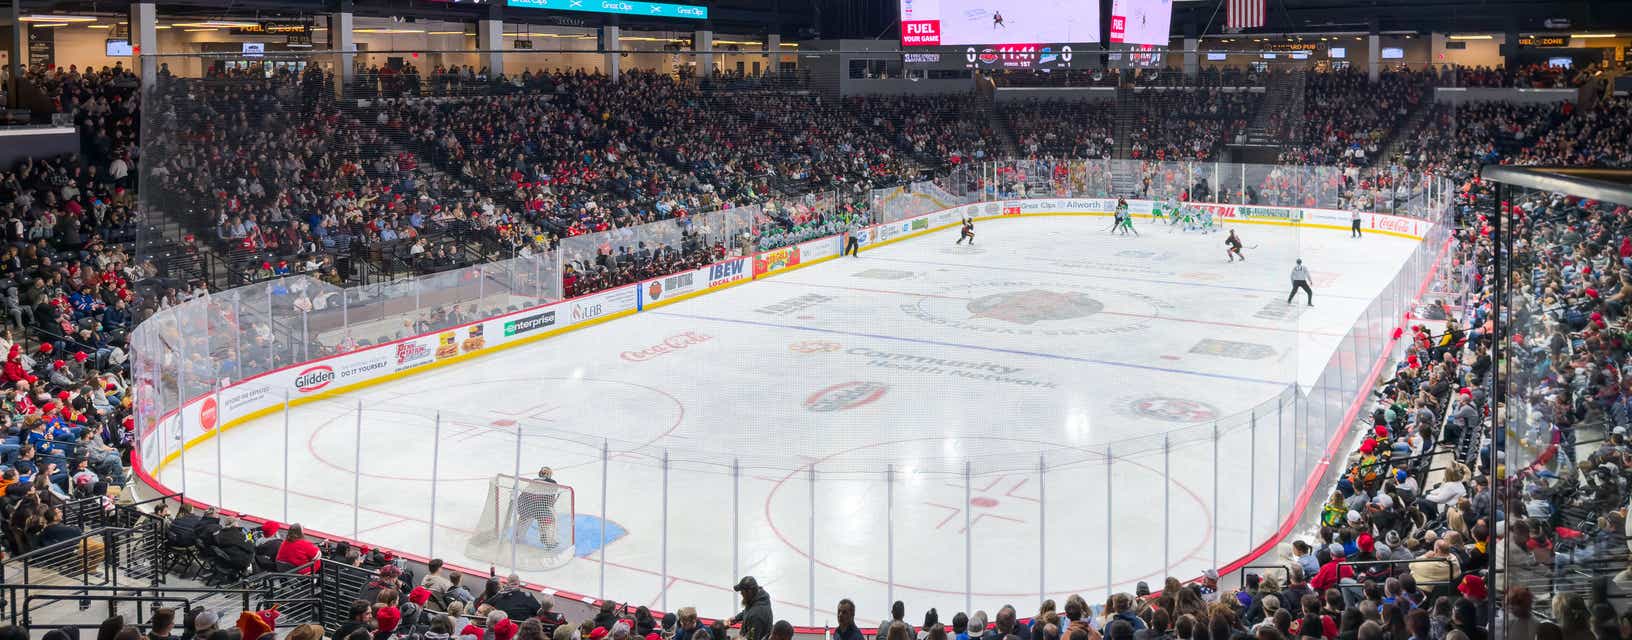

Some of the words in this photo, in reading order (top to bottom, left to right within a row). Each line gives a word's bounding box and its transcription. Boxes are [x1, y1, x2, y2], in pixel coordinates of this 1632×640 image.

[907, 23, 935, 34] FUEL
[966, 47, 976, 62] 0
[1000, 46, 1035, 60] 11:41
[1062, 46, 1072, 62] 0
[1021, 201, 1039, 209] Great
[1040, 200, 1056, 209] Clips
[1066, 200, 1101, 209] Allworth
[709, 259, 745, 281] IBEW
[709, 277, 729, 287] LOCAL
[507, 314, 556, 332] enterprise
[620, 330, 712, 362] Coca-Cola
[358, 361, 388, 373] YOURSELF
[295, 370, 335, 388] Glidden
